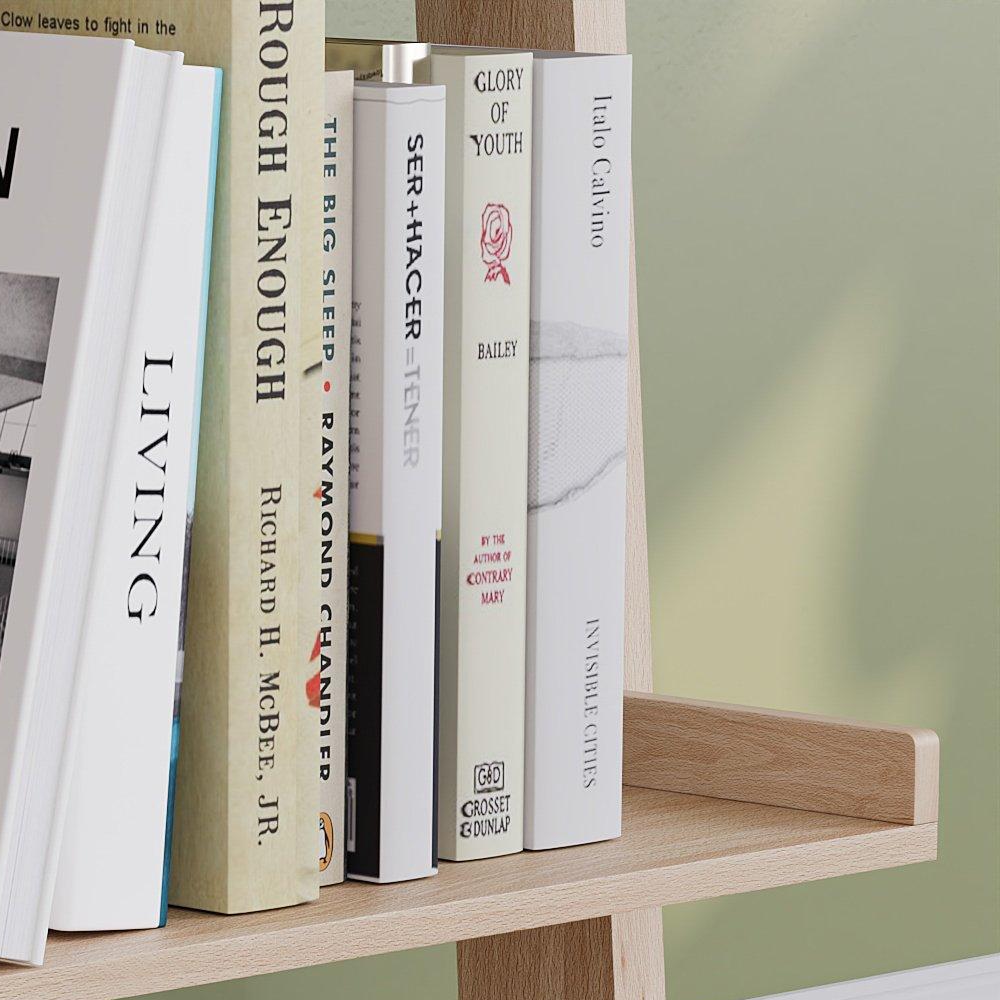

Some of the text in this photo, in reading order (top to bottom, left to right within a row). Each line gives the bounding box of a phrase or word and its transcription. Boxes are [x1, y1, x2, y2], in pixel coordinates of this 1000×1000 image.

[1, 11, 34, 28] Clow
[38, 13, 80, 30] leaves
[85, 16, 99, 31] to
[104, 16, 132, 36] fight
[137, 18, 149, 34] in
[155, 20, 176, 35] the
[474, 68, 524, 94] GLORY
[490, 101, 509, 124] OF
[323, 117, 337, 178] THE
[469, 131, 523, 157] YOUTH
[591, 95, 613, 248] Italo Calvino
[256, 0, 294, 404] ROUGH ENOUGH
[323, 194, 336, 252] BIG
[322, 270, 336, 362] SLEEP
[478, 340, 517, 360] BAILEY
[127, 351, 174, 623] LIVING
[321, 413, 334, 588] RAYMOND
[259, 484, 282, 614] RICHARD
[481, 533, 505, 547] BY THE
[473, 552, 501, 564] AUTHOR
[466, 567, 513, 586] CONTRARY
[481, 589, 505, 605] MARY
[258, 625, 281, 658] H.
[584, 618, 600, 789] INVISIBLE CITIES
[257, 794, 280, 846] JR.
[461, 794, 511, 818] GROSSET
[474, 815, 511, 838] DUNLAP
